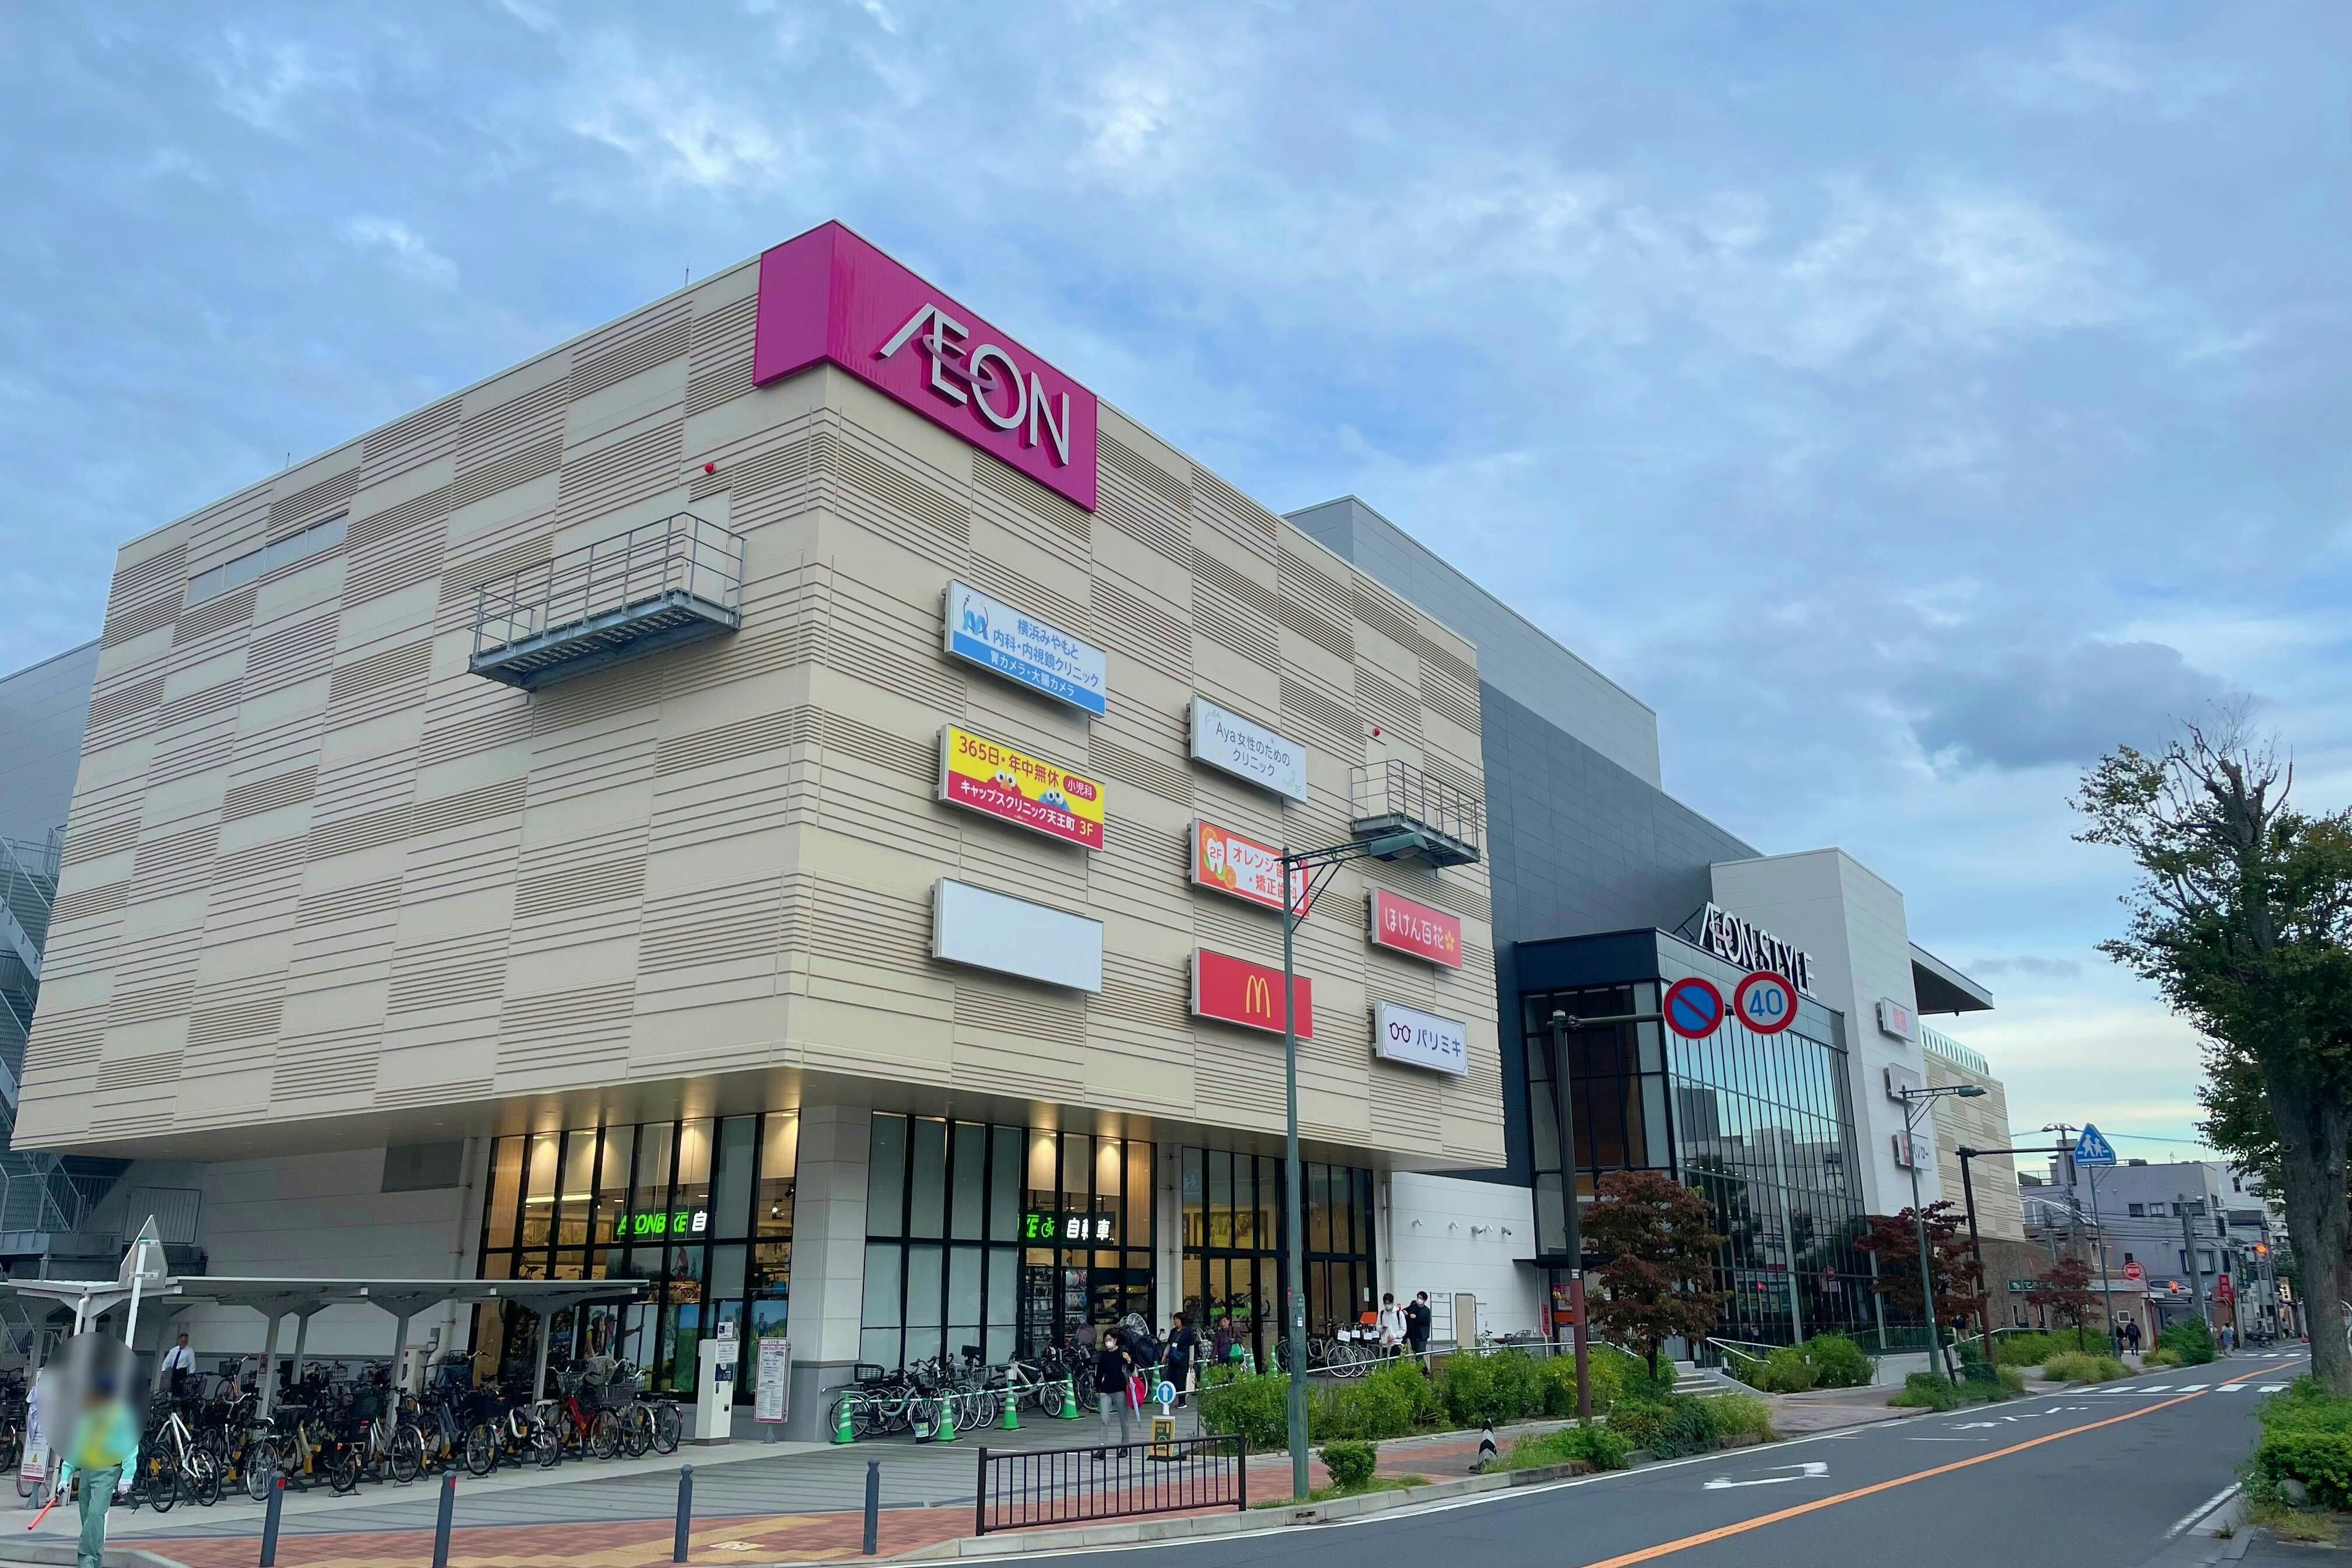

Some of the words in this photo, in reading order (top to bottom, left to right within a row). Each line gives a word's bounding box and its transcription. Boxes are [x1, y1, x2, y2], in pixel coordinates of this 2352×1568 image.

[993, 629, 1099, 688] 内科・内視鏡クリニック
[1017, 618, 1079, 660] 横浜みやもと
[991, 650, 1074, 696] 胃カメラ・大腸カメラ
[958, 736, 1059, 788] 365日・年中無休
[1233, 748, 1275, 776] クリニック
[961, 780, 1075, 831] キャップスクリニック天王町
[1079, 820, 1094, 837] 3F
[1067, 779, 1093, 799] 小児科
[1385, 907, 1444, 950] ほけん百花
[1749, 988, 1783, 1017] 40
[1417, 1028, 1461, 1057] パリミキ
